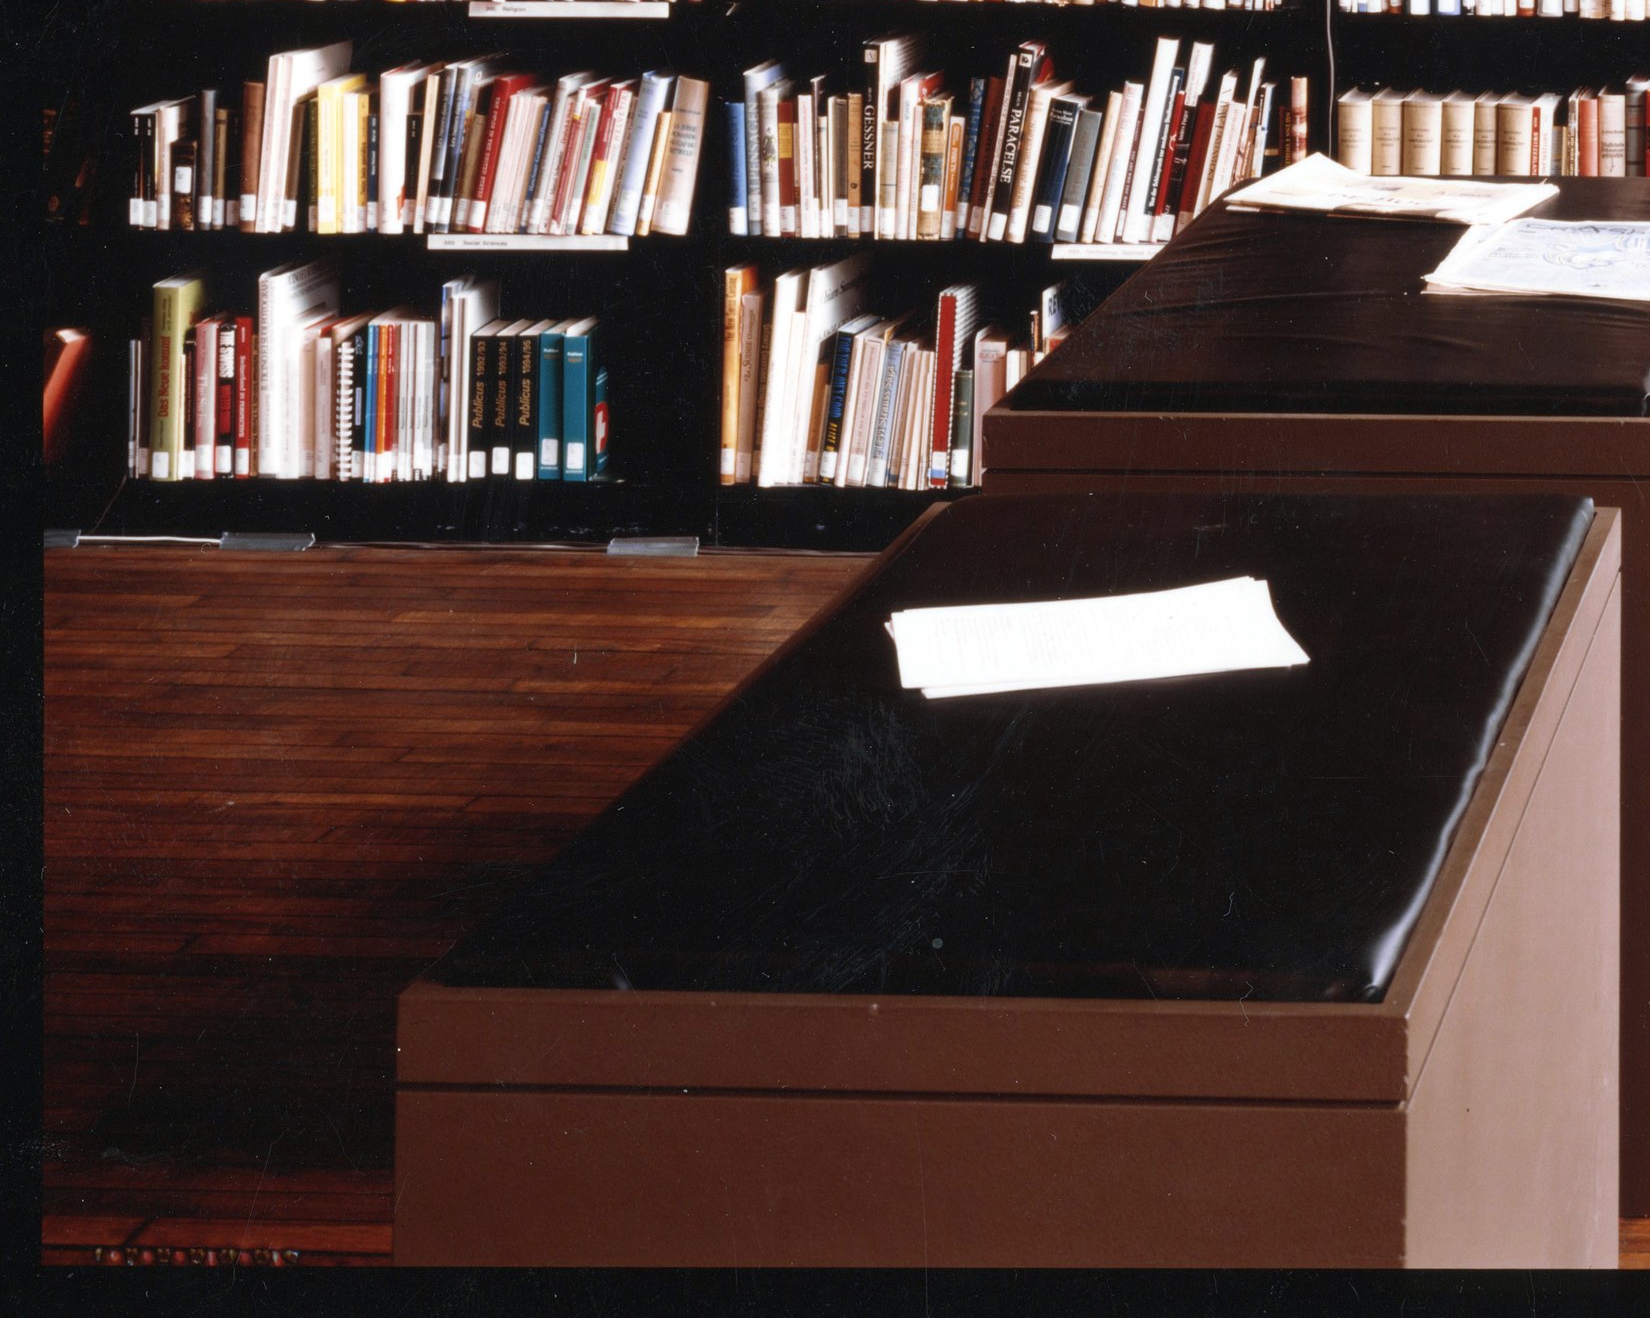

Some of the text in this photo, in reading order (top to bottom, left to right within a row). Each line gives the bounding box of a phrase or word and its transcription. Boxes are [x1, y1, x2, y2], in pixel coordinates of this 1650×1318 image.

[490, 110, 499, 129] SWISS
[863, 104, 875, 170] GESSNER
[1284, 111, 1292, 137] SWISS
[481, 152, 491, 174] UNITED
[999, 108, 1024, 184] PARACELSE
[477, 175, 486, 199] STATES
[725, 319, 736, 331] New
[219, 330, 235, 379] THE SWISS
[838, 336, 853, 352] FOR
[159, 336, 171, 417] Das Neue kommt
[239, 355, 247, 391] Switzerland
[472, 340, 487, 429] Publicus 1992/93
[494, 341, 508, 427] Publicus 1993/94
[519, 339, 533, 426] Publicus 1994/95
[831, 395, 845, 418] GOOD
[874, 365, 897, 450] Levi Strauss Saga
[827, 422, 838, 445] ALICE
